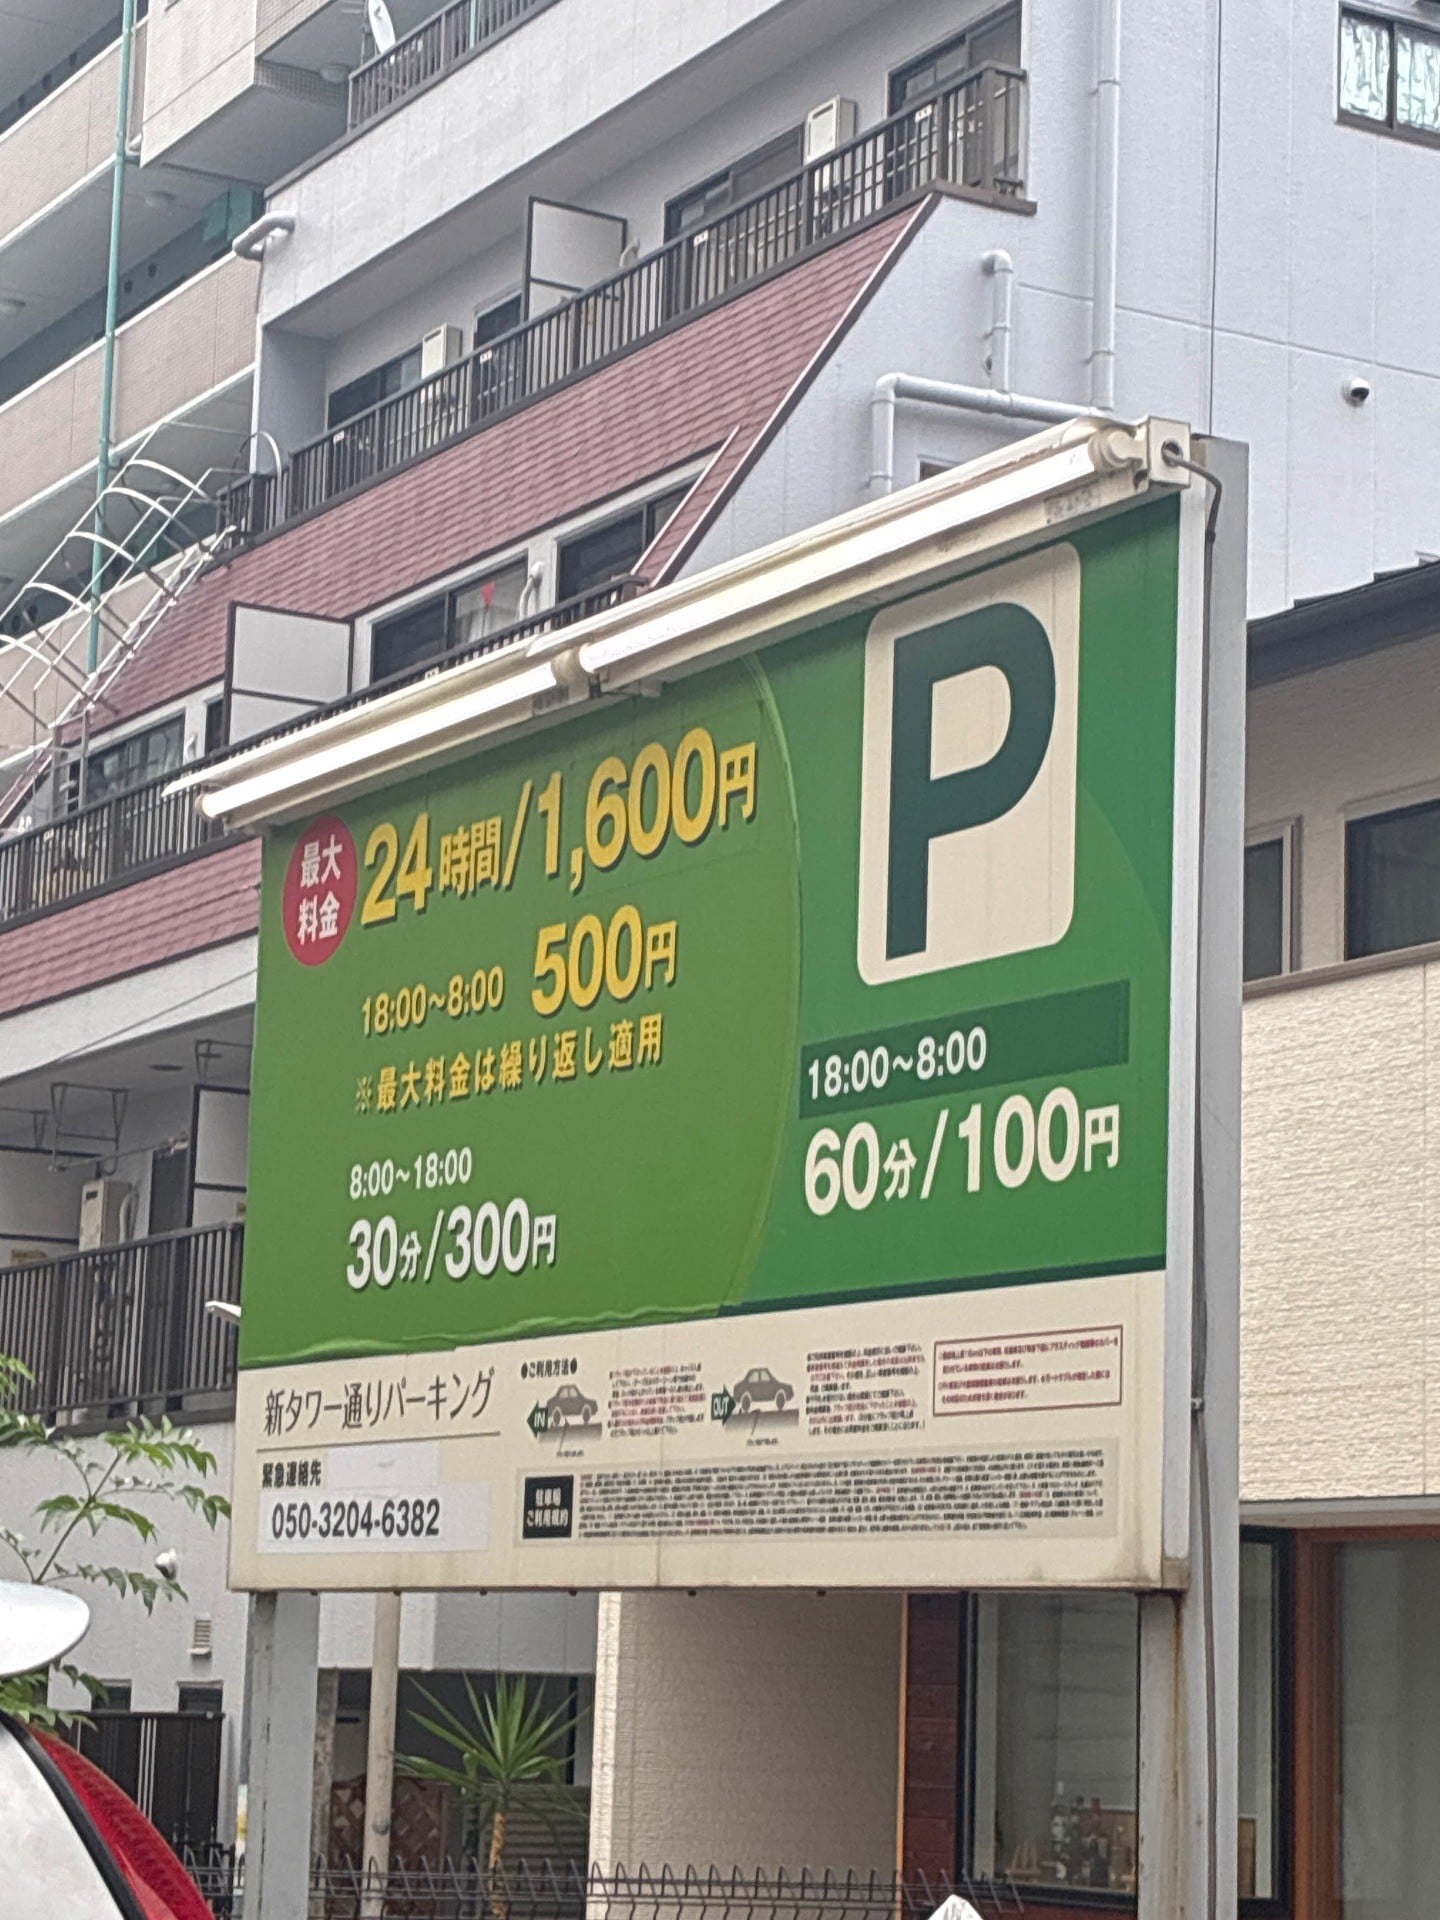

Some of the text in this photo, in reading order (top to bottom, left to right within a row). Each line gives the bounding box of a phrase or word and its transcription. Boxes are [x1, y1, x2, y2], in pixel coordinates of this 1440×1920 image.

[886, 601, 1056, 962] P
[300, 834, 343, 888] 最大
[298, 891, 341, 946] 料金
[532, 904, 677, 1015] 500円
[804, 1085, 1120, 1216] 60分/100円
[346, 1198, 557, 1290] 30分/300円
[263, 1366, 495, 1437] 新タワー通りパーキング
[271, 1498, 440, 1540] 050-3204-6382
